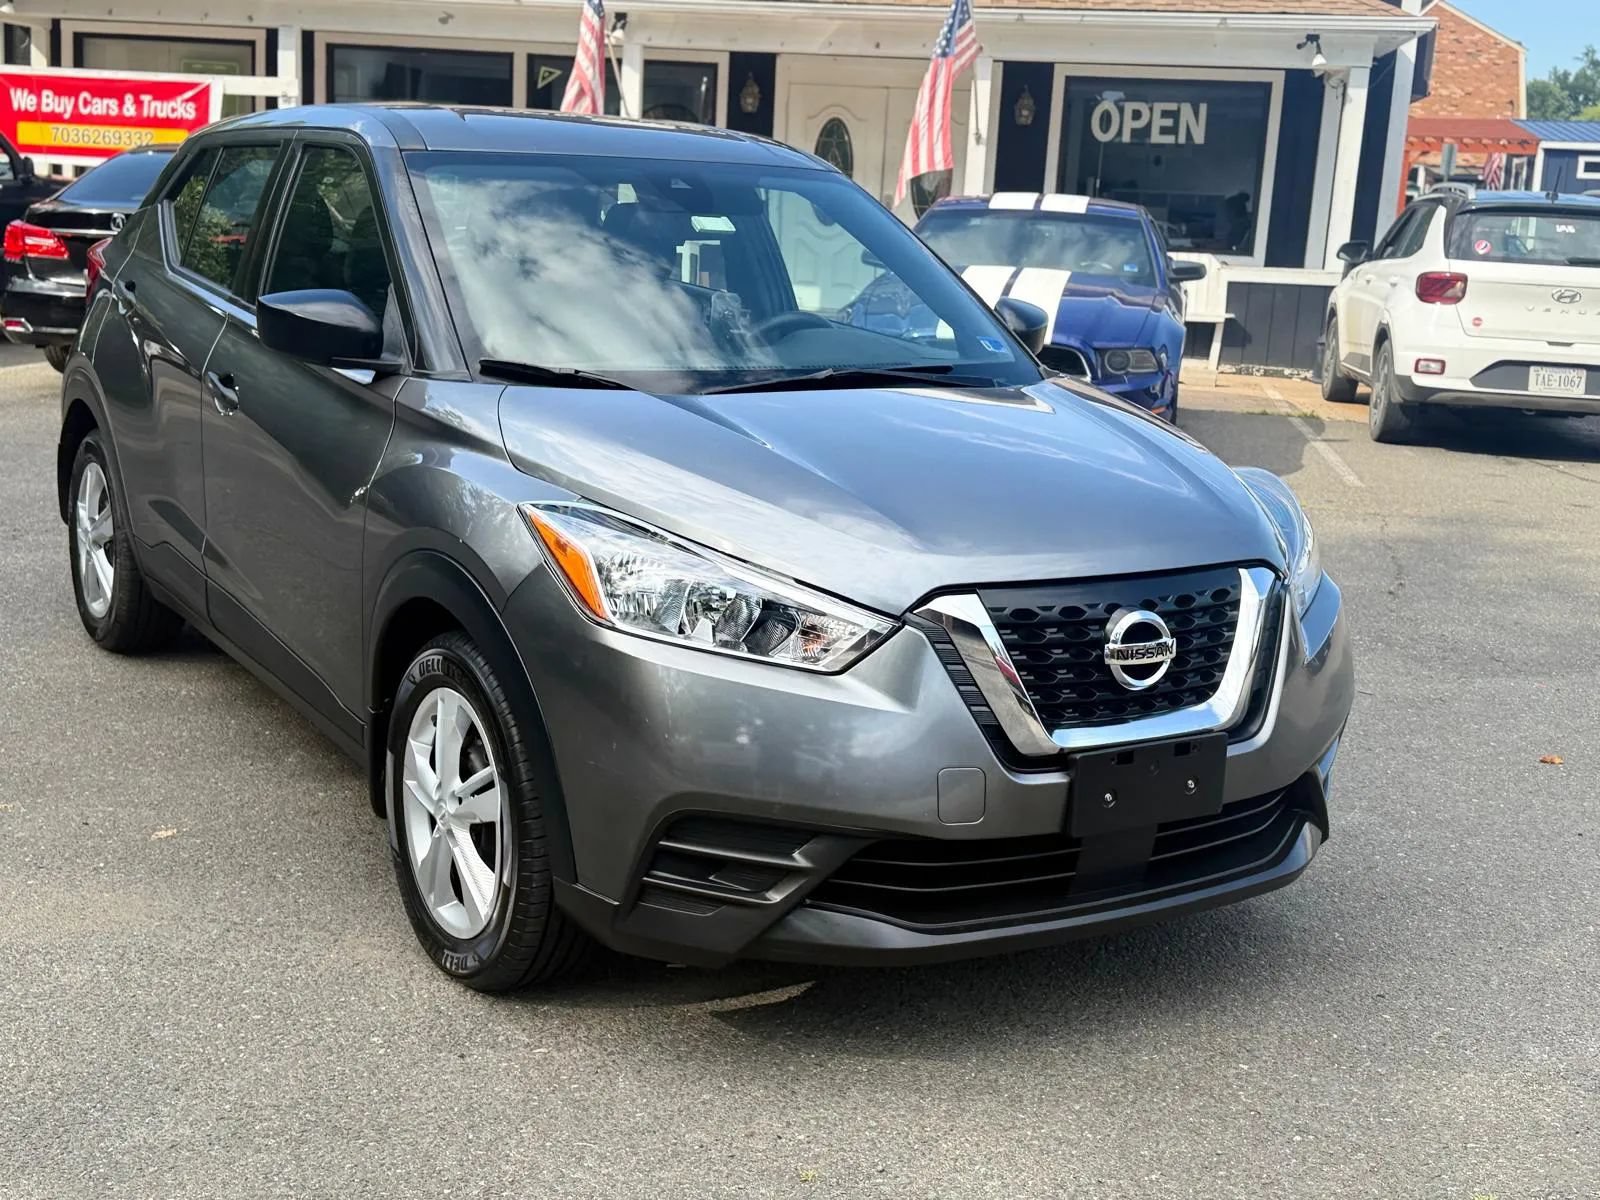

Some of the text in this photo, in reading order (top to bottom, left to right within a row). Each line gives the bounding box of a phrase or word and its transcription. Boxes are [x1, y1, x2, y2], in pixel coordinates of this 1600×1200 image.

[10, 87, 196, 120] We Buy Cars & Trucks
[1091, 100, 1207, 144] OPEN
[51, 126, 154, 147] 7036269332
[1535, 373, 1582, 388] TAE-1067
[1116, 640, 1175, 660] NISSAN
